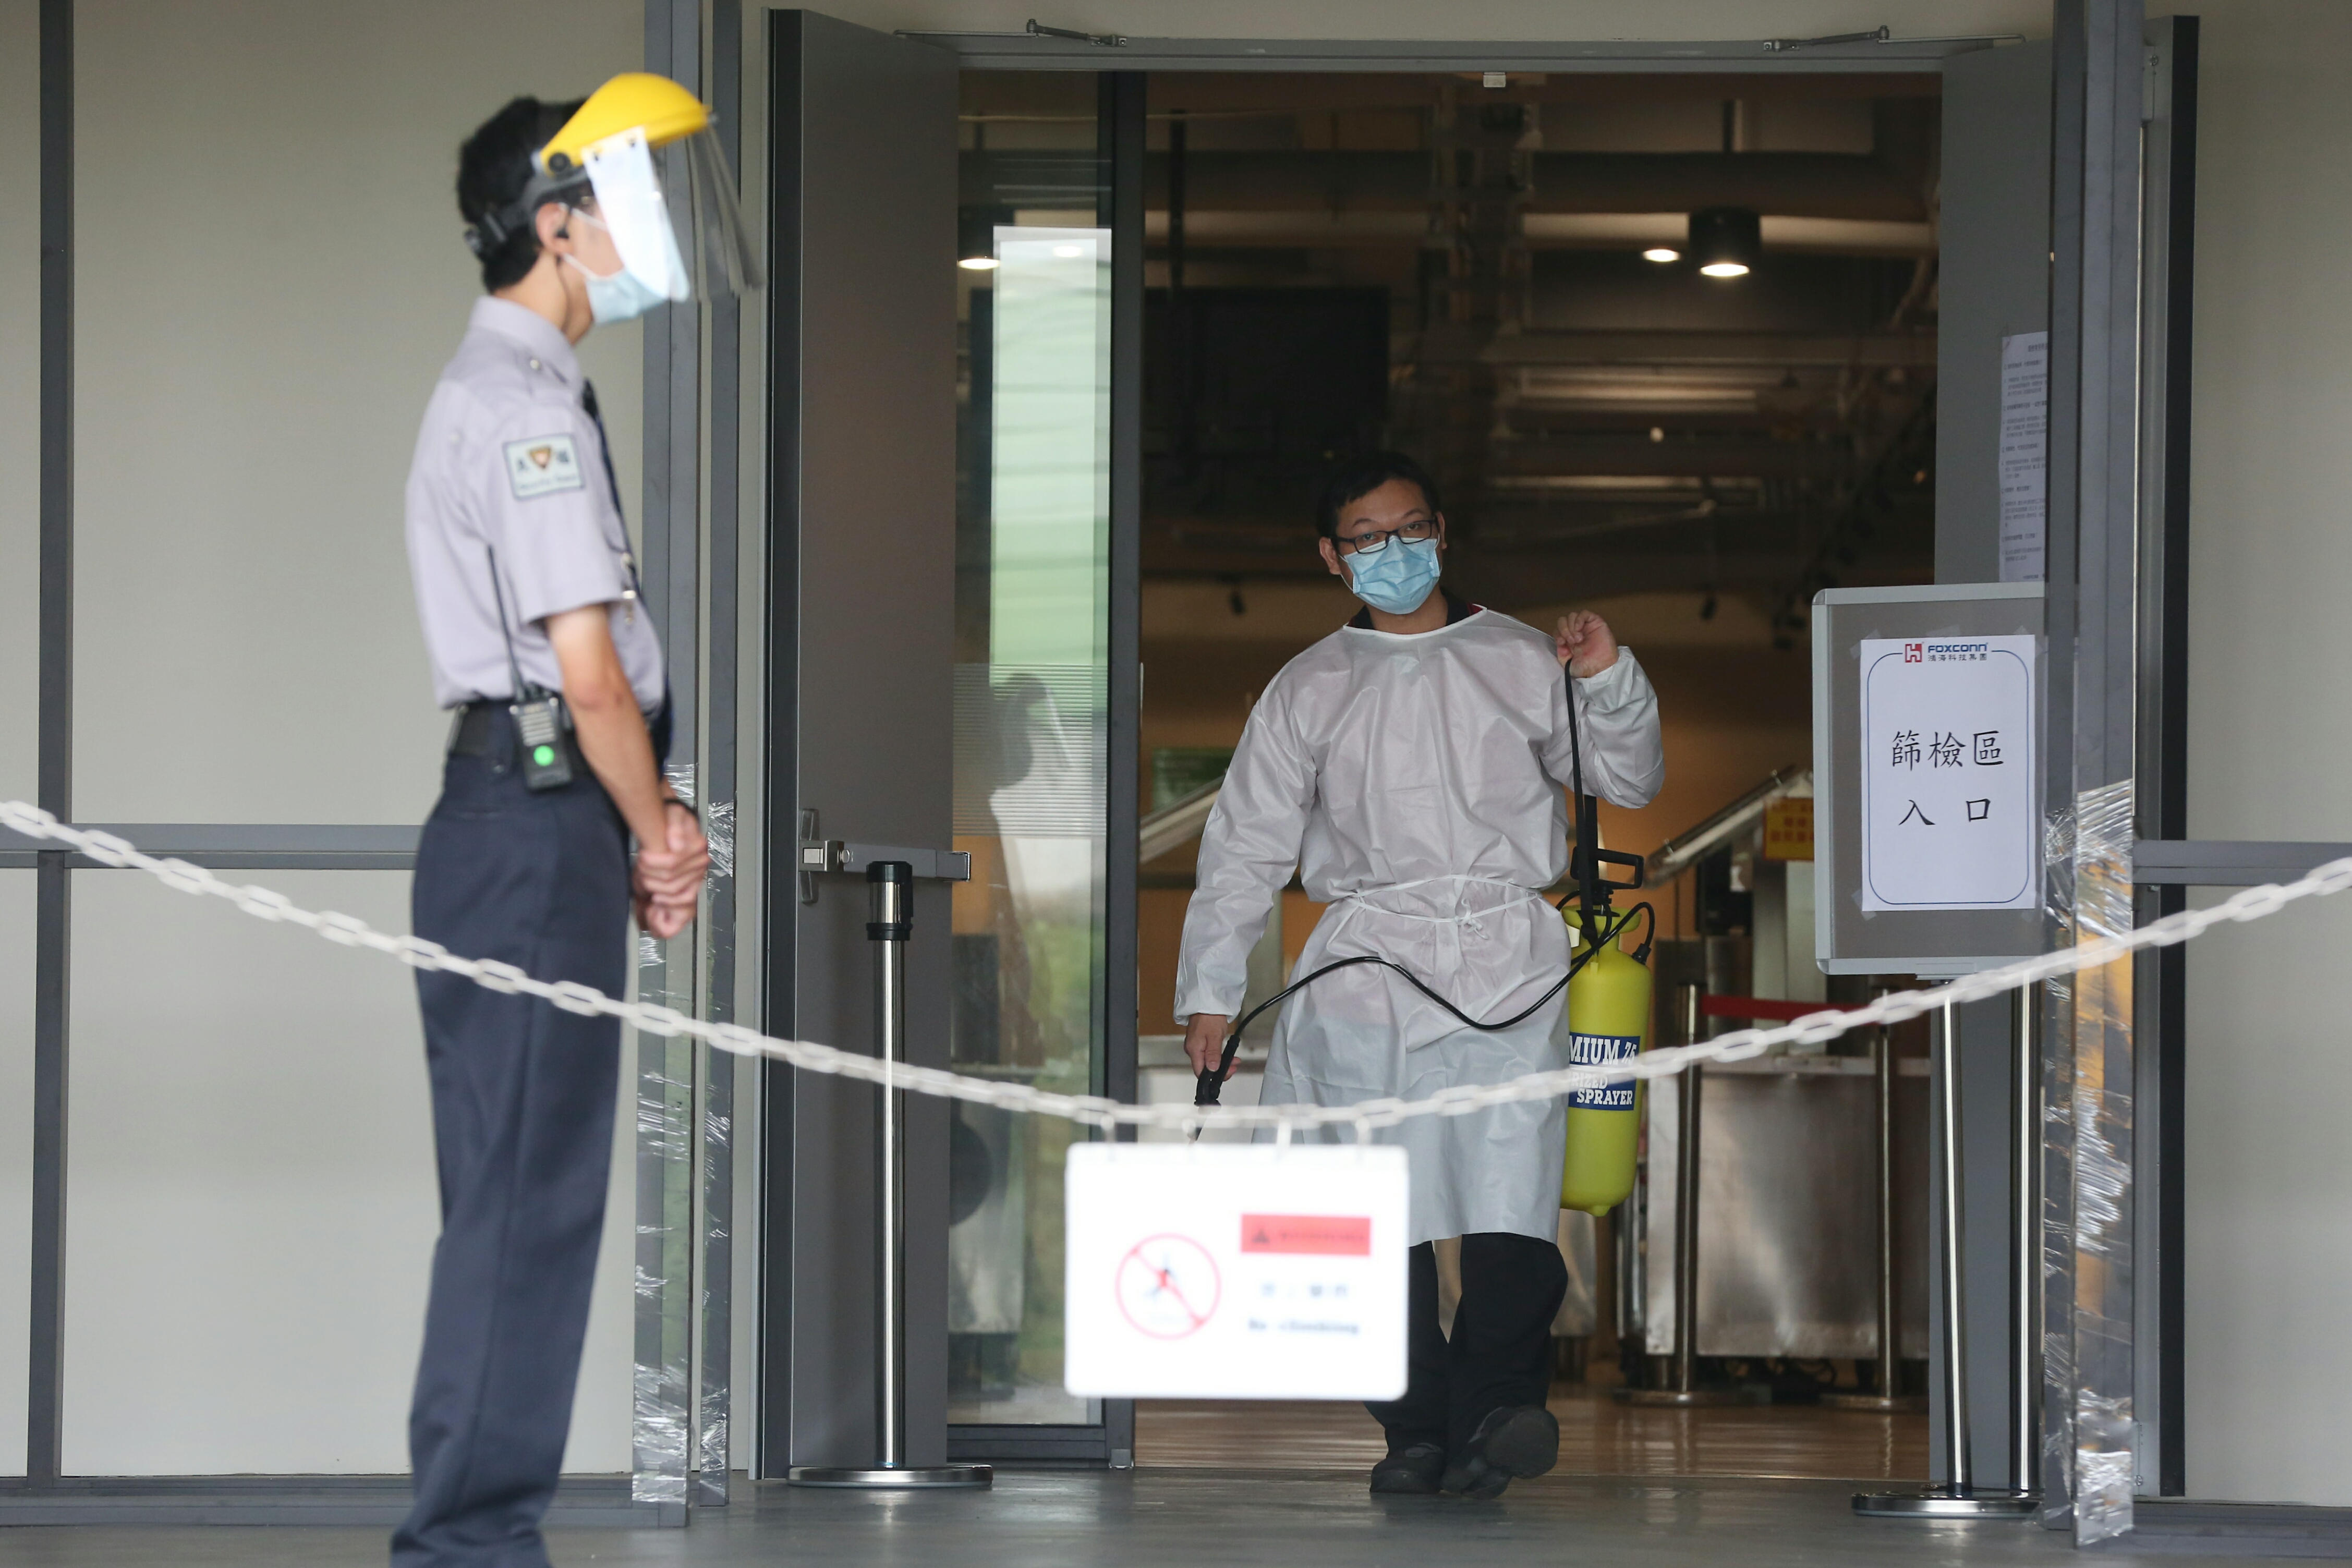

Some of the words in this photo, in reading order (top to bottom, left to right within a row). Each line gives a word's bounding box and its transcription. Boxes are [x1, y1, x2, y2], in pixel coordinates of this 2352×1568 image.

[1892, 730, 2004, 771] 篩檢區
[1898, 798, 1991, 826] 入口
[1577, 1088, 1633, 1105] SPRAYER
